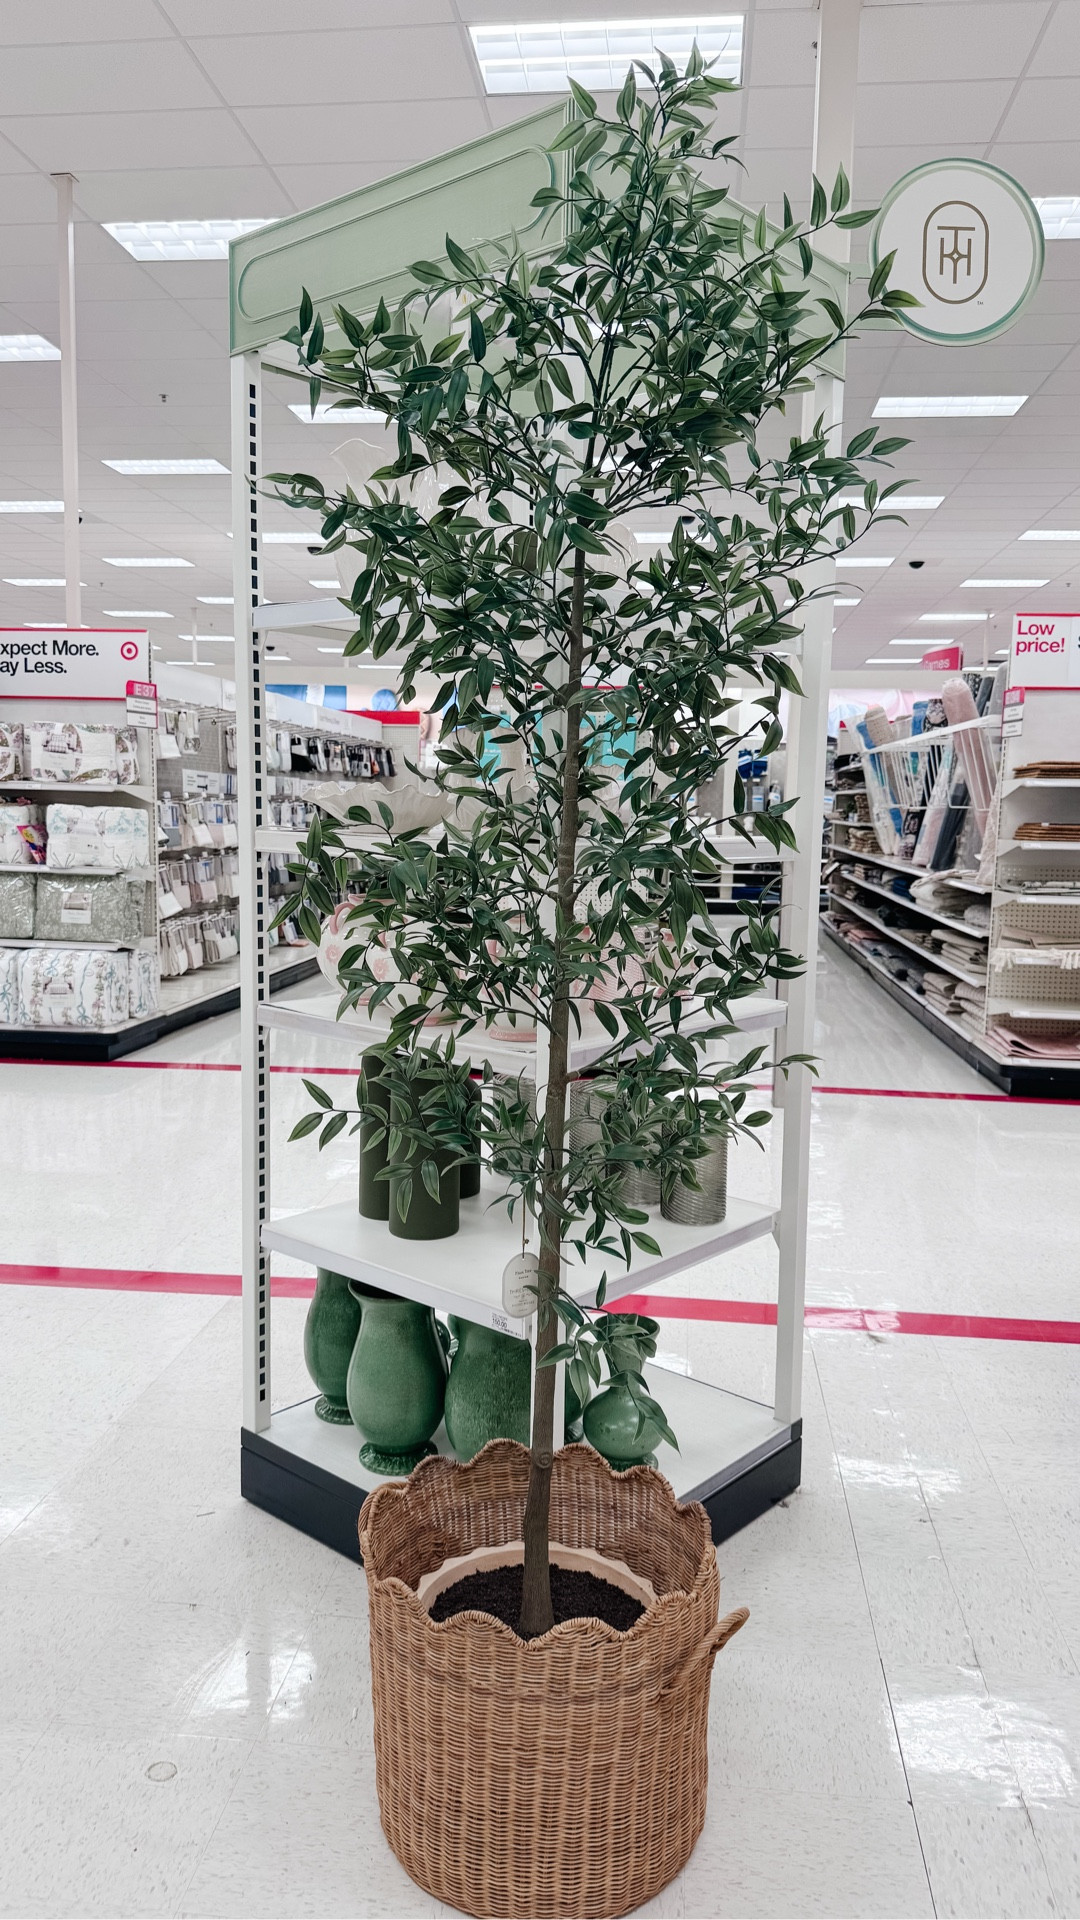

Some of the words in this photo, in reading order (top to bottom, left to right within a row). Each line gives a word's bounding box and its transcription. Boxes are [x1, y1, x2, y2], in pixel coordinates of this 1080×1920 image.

[1016, 620, 1055, 636] Low
[52, 640, 100, 656] More.
[1015, 637, 1066, 656] price!
[24, 657, 68, 674] Less.
